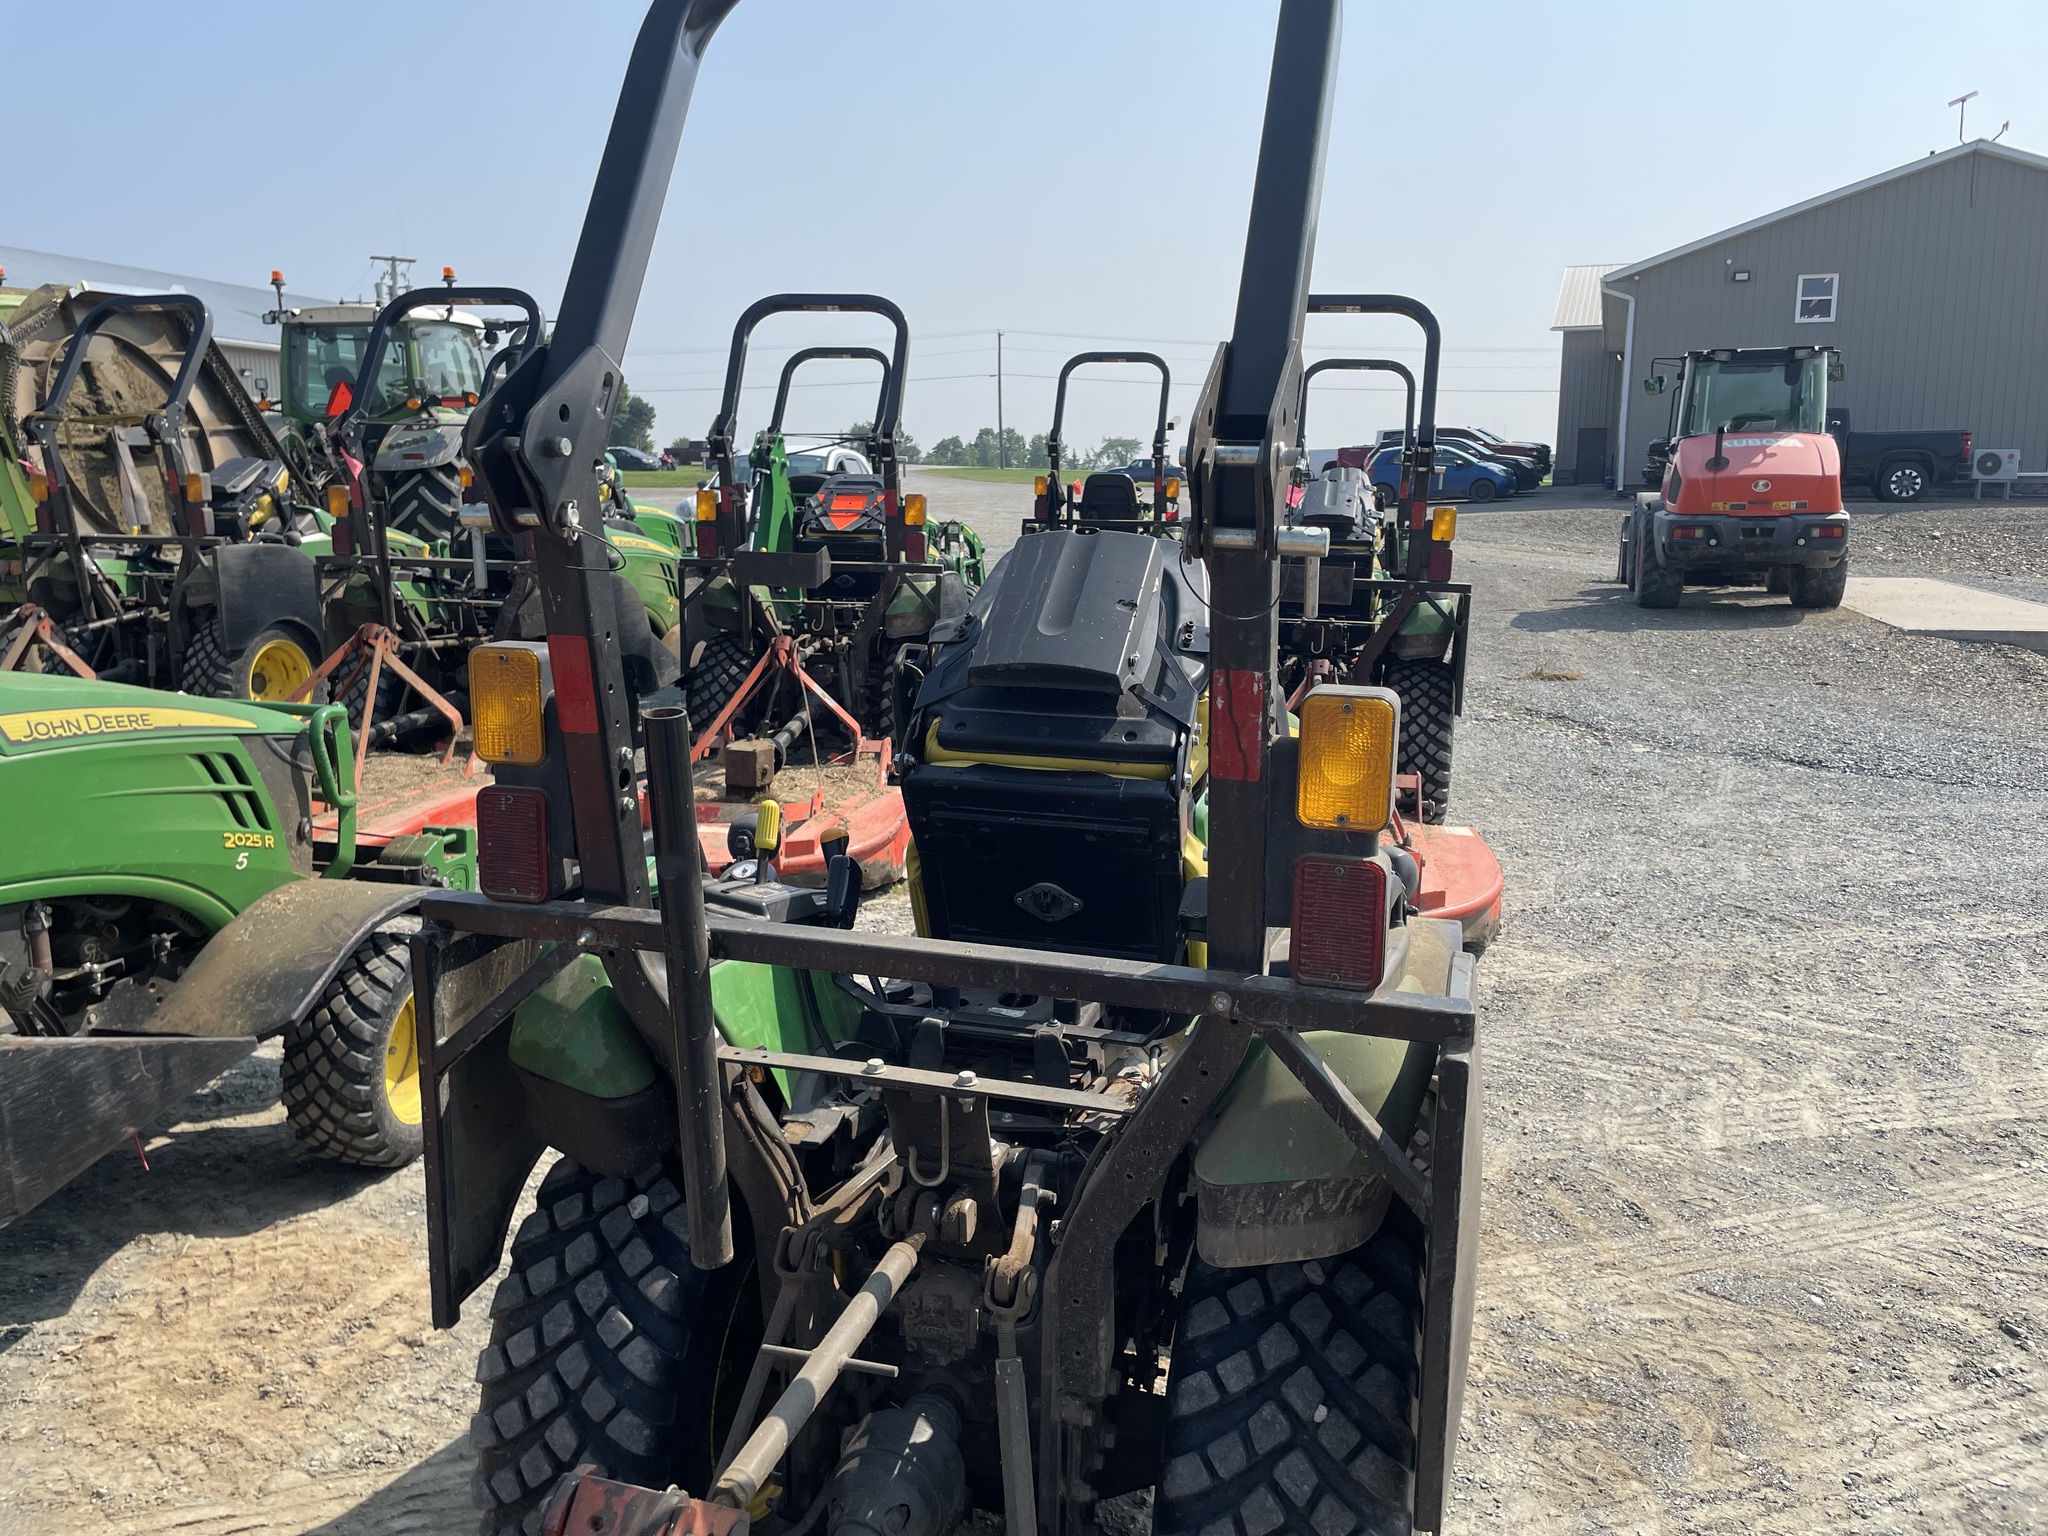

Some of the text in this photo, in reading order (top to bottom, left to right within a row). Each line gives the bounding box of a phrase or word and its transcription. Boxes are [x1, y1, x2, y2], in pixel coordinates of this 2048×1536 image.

[22, 713, 154, 739] JOHN DEERE
[223, 832, 275, 849] 2025 R
[235, 851, 250, 871] 5
